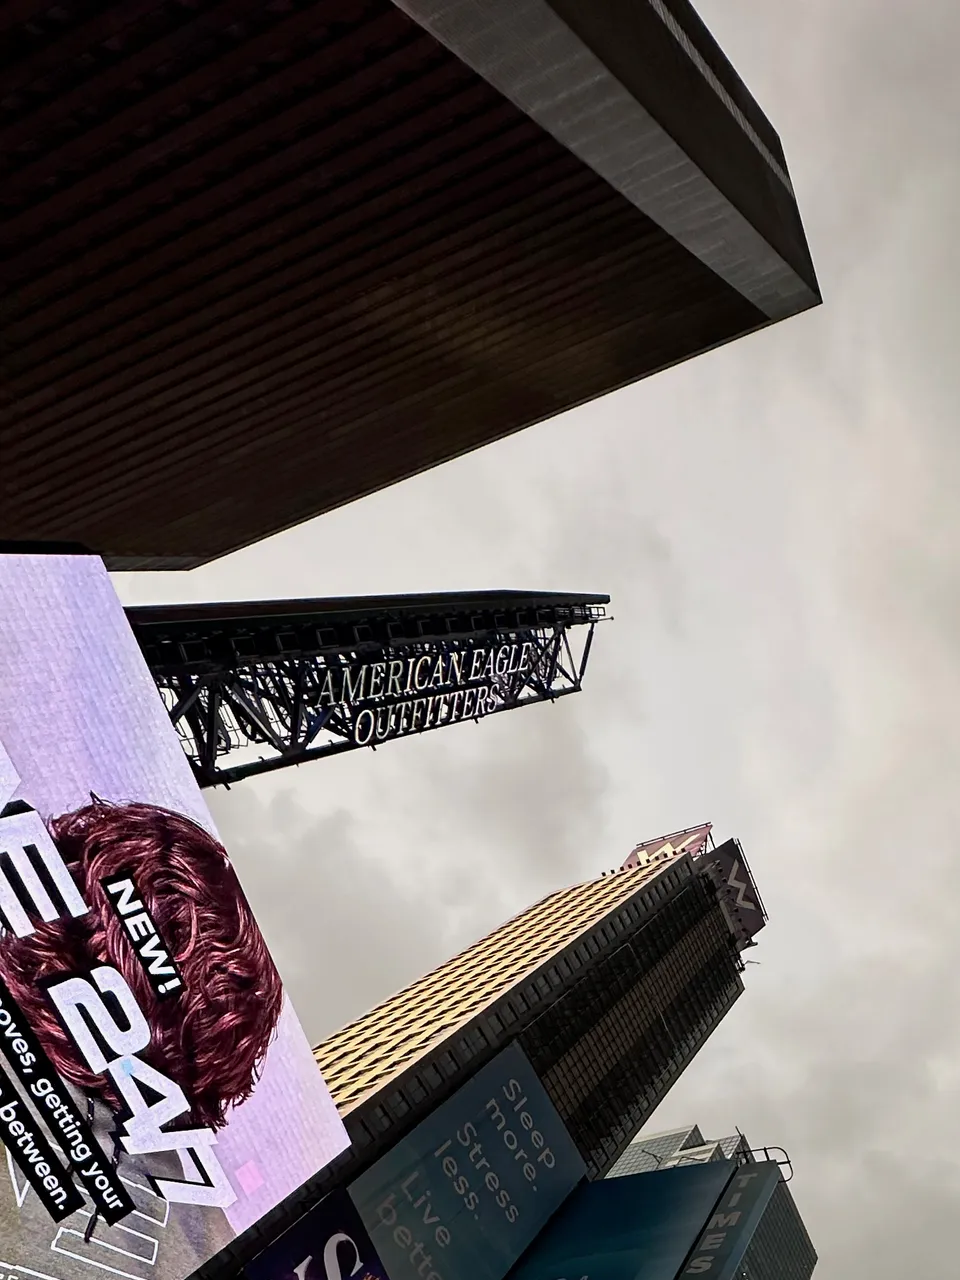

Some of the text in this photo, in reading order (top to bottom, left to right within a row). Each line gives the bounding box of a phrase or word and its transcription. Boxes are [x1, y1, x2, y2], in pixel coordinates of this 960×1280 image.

[315, 642, 532, 708] AMERICAN EAGLE
[356, 684, 500, 745] OUTFITTERS
[107, 878, 182, 995] NEW!
[0, 1003, 124, 1210] oves, getting your
[485, 1098, 538, 1192] more.
[502, 1078, 556, 1169] Sleep
[0, 1100, 71, 1211] between.
[434, 1139, 480, 1221] less.
[456, 1121, 519, 1223] Stress
[400, 1171, 451, 1248] Live
[685, 1172, 759, 1274] TIMES
